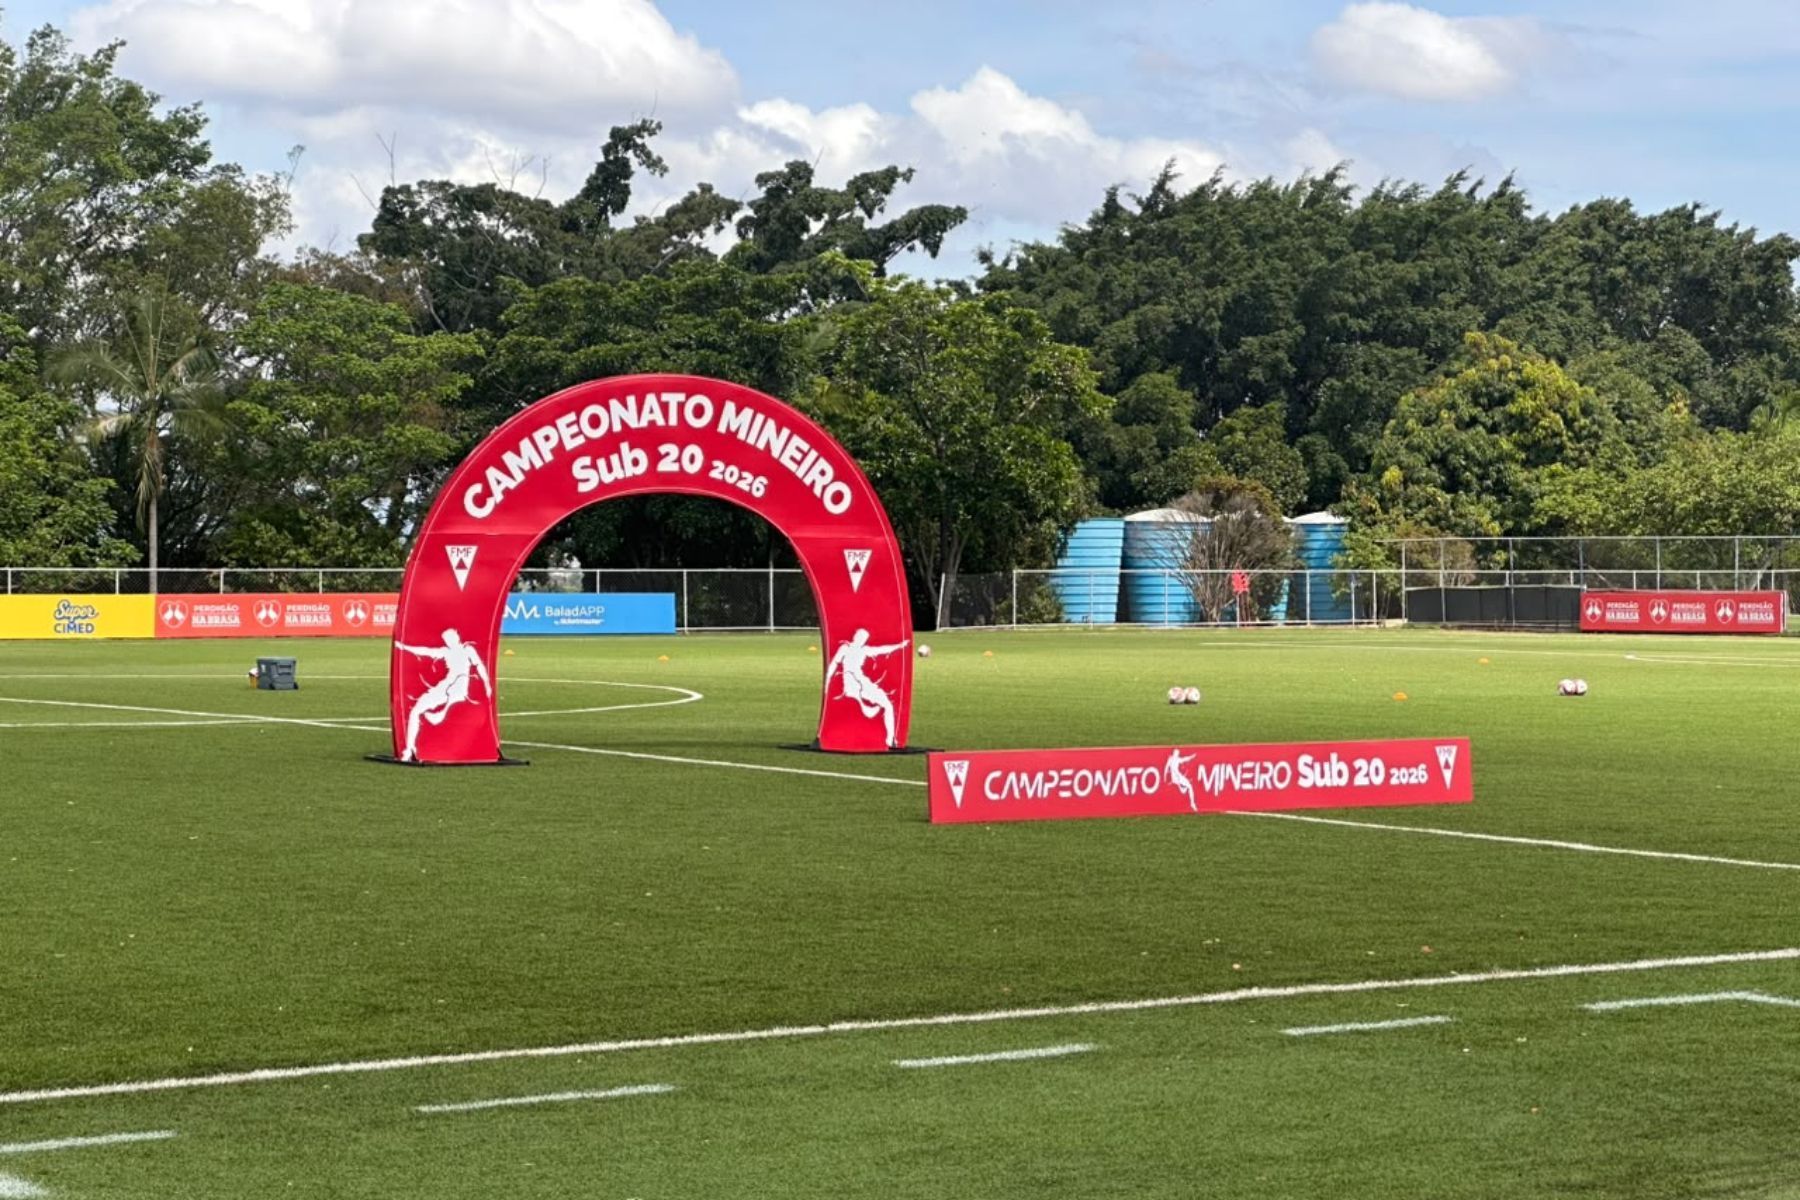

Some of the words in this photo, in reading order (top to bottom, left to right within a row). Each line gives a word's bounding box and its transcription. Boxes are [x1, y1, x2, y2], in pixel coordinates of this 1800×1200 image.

[464, 392, 713, 519] CAMPEONATO
[717, 401, 852, 515] MINEIRO
[572, 442, 648, 493] Sub
[656, 443, 704, 474] 20
[709, 460, 768, 498] 2026
[450, 547, 473, 557] FMF
[55, 599, 98, 622] Super
[545, 605, 605, 617] BaladAPP
[54, 623, 94, 634] CIMED
[984, 766, 1161, 800] CAMPEONATO
[1197, 760, 1292, 797] MINEIRO
[1297, 752, 1349, 788] Sub
[1353, 757, 1386, 787] 20
[1389, 763, 1429, 785] 2026
